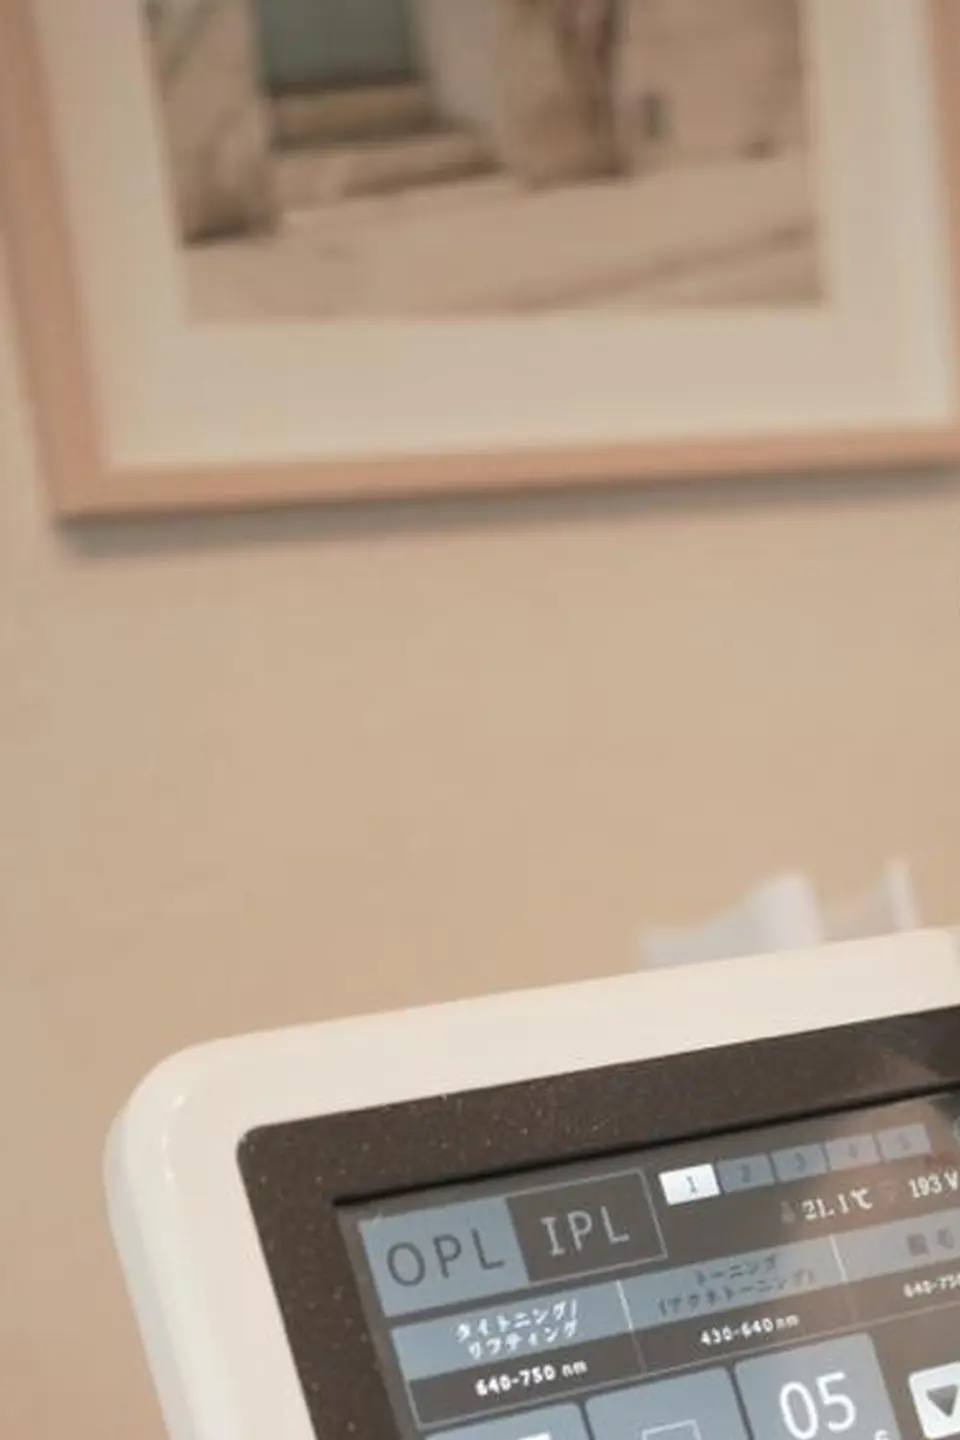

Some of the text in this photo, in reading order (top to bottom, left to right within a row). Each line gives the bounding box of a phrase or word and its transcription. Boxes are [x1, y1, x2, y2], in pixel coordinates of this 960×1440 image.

[685, 1175, 698, 1194] 1
[943, 1168, 960, 1192] V
[540, 1206, 630, 1256] IPL
[386, 1227, 506, 1287] OPL
[775, 1313, 800, 1331] nm
[474, 1360, 588, 1397] 640-750 nm
